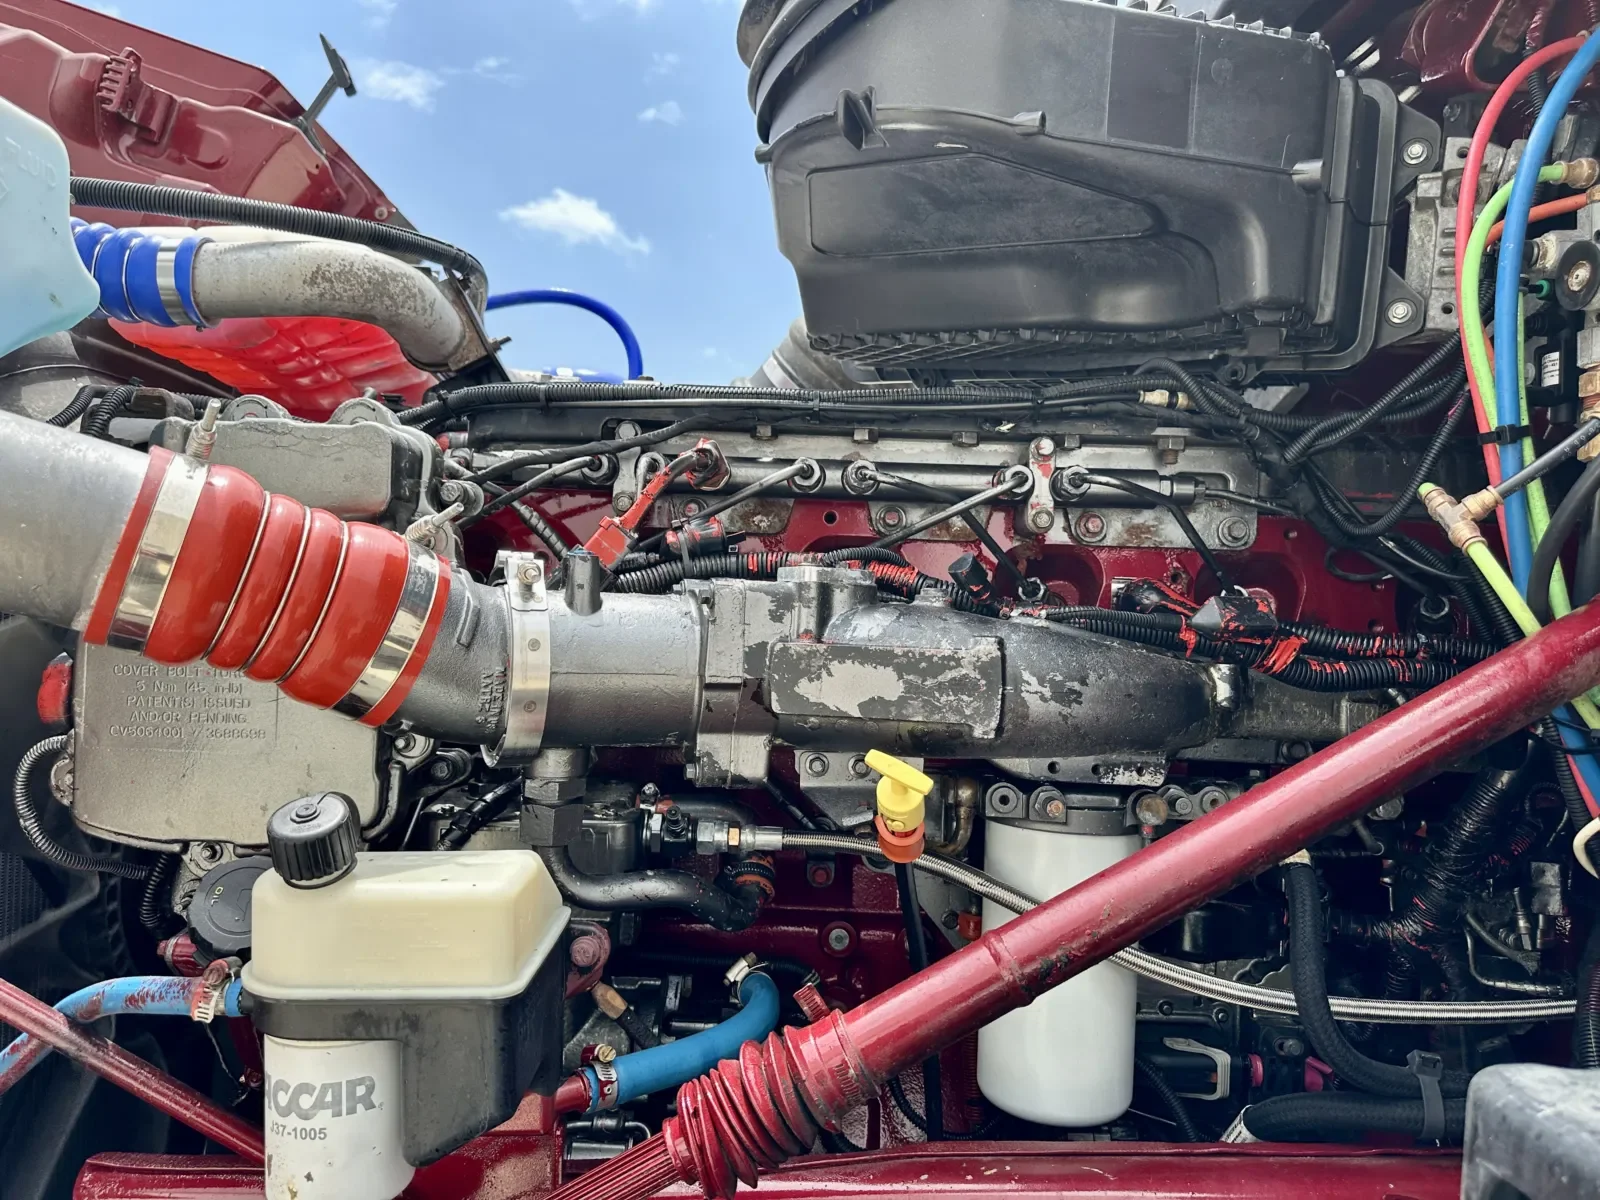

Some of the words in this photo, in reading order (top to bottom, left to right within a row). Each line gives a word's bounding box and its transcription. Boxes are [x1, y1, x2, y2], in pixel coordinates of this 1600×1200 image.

[113, 664, 158, 677] COVER
[167, 666, 202, 678] BOLT
[135, 680, 146, 692] 5
[126, 695, 197, 709] PATENT(S)
[204, 697, 251, 709] ISSUED
[130, 710, 182, 723] AND/OR
[109, 725, 184, 738] CV5064001
[211, 886, 224, 907] OIL
[270, 1120, 328, 1141] J37-1005
